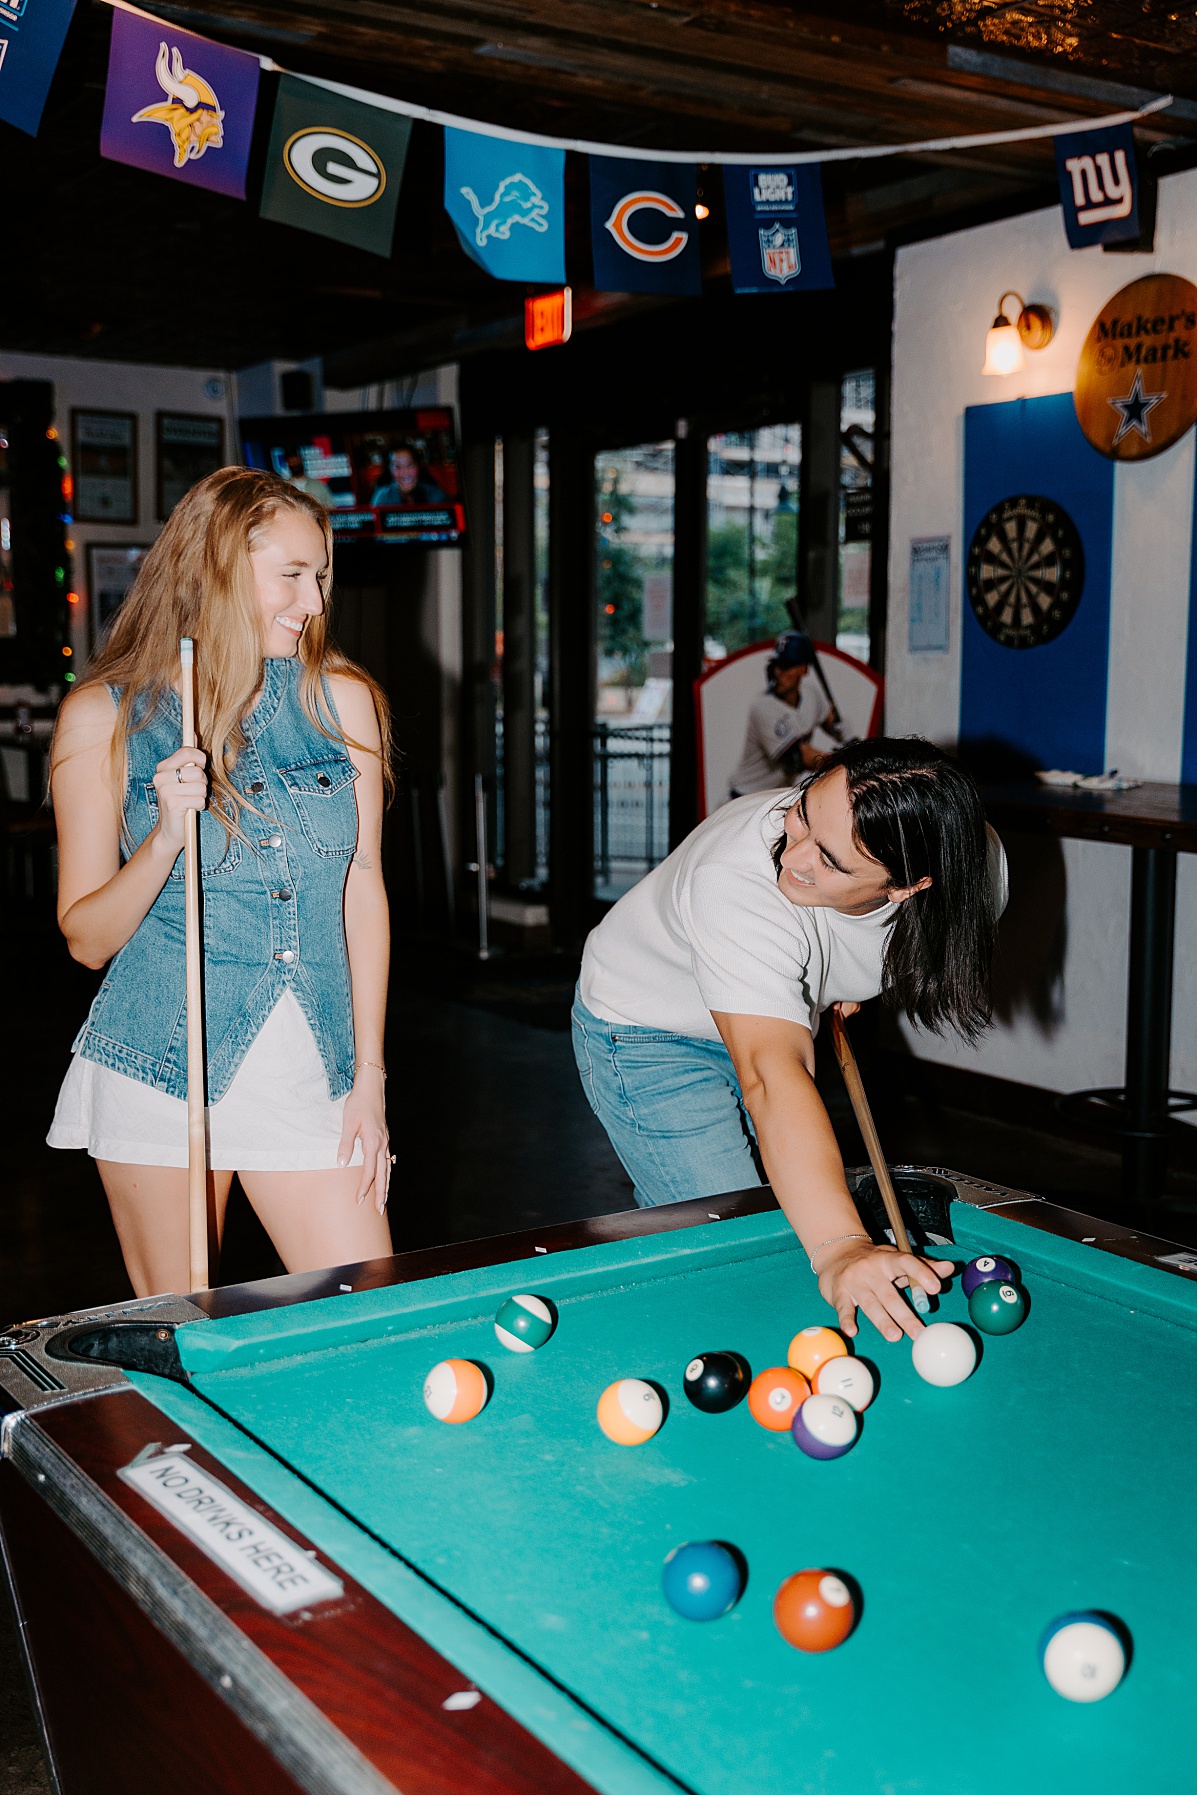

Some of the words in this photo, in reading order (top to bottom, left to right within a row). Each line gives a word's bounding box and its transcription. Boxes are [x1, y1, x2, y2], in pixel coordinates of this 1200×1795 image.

[758, 172, 788, 187] BUD
[753, 186, 794, 202] LIGHT
[766, 249, 797, 274] NFL
[1097, 309, 1196, 343] Maker's
[1119, 337, 1190, 369] Mark
[983, 1259, 990, 1268] 4
[150, 1465, 189, 1489] NO
[176, 1487, 254, 1542] DRINKS
[240, 1540, 310, 1591] HERE
